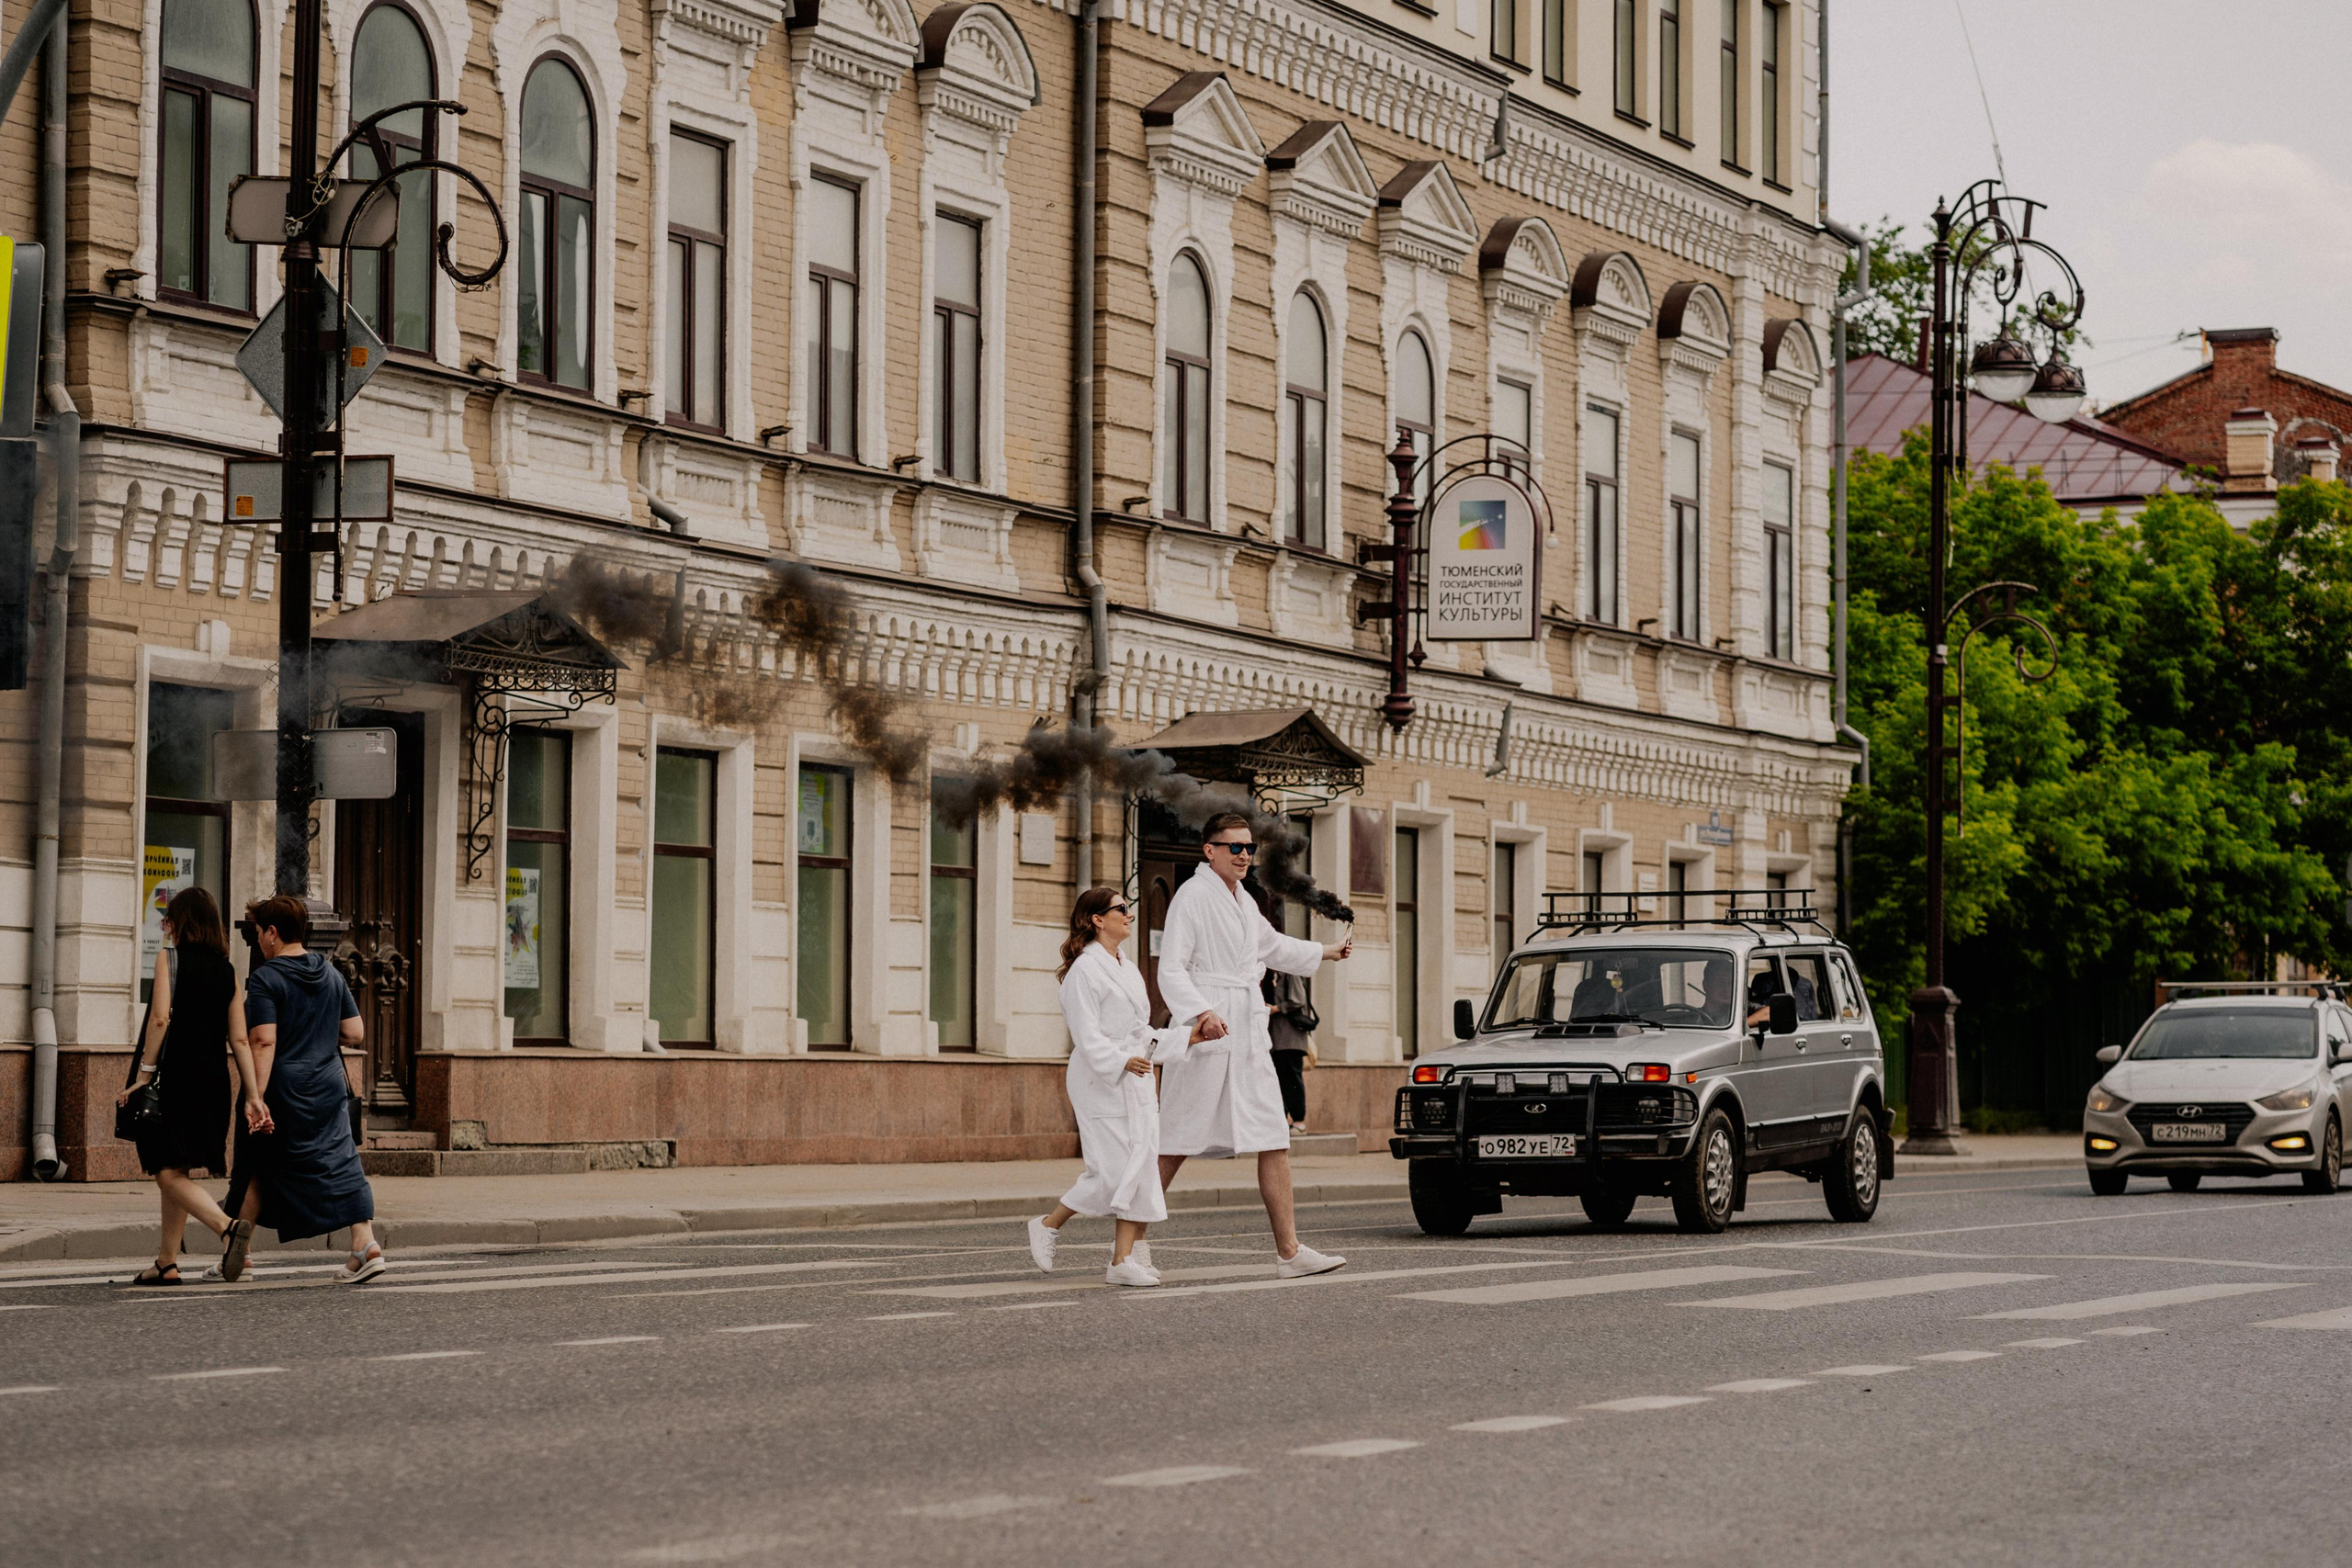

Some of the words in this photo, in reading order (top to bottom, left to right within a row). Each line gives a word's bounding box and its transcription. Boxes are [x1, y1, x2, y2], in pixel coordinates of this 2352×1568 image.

[1441, 563, 1523, 577] ТЮМЕНСКИЙ
[1440, 579, 1523, 589] ГОСУДАРСТВЕННЫЙ
[1440, 591, 1522, 605] ИНСТИТУТ
[1439, 607, 1522, 621] КУЛЬТУРЫ
[2208, 1124, 2222, 1135] 72
[1553, 1136, 1570, 1149] 72
